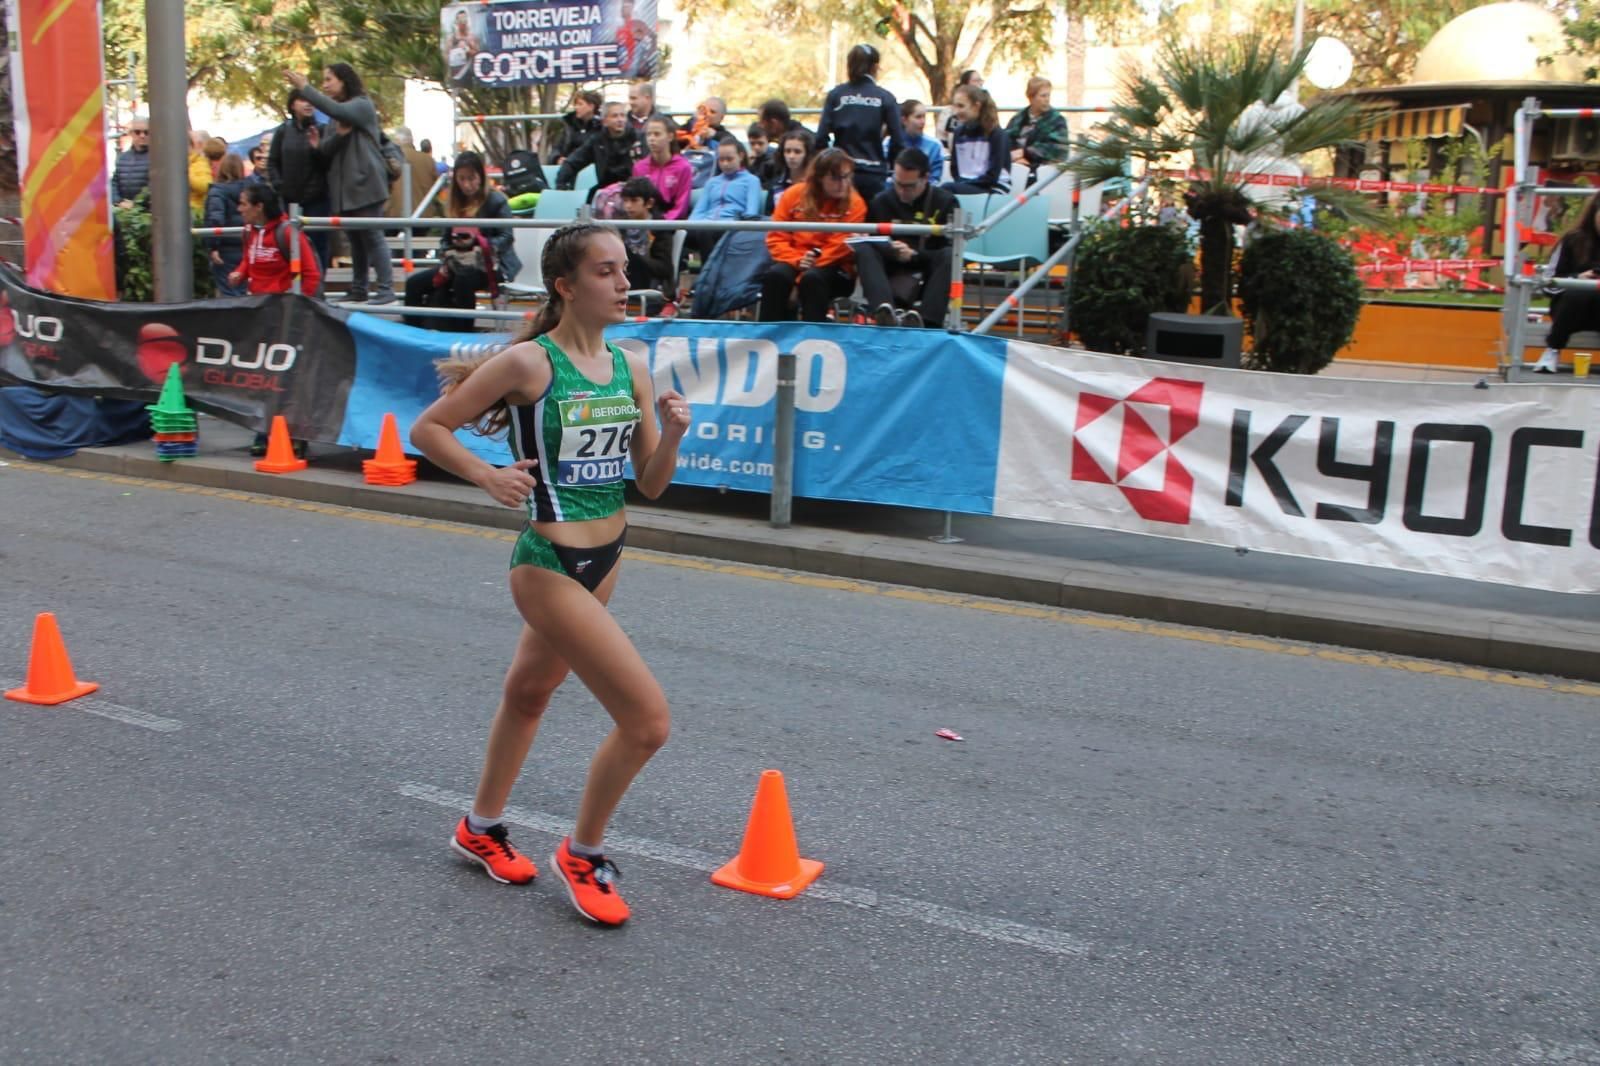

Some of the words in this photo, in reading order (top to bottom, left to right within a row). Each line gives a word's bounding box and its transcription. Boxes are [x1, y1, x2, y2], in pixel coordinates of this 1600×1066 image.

[492, 6, 601, 31] TORREVIEJA
[501, 31, 558, 49] MARCHA
[560, 29, 591, 45] CON
[473, 45, 621, 83] CORCHETE
[196, 336, 297, 371] DJO
[203, 368, 287, 392] GLOBAL
[576, 424, 633, 458] 276
[1224, 408, 1600, 549] KYOC
